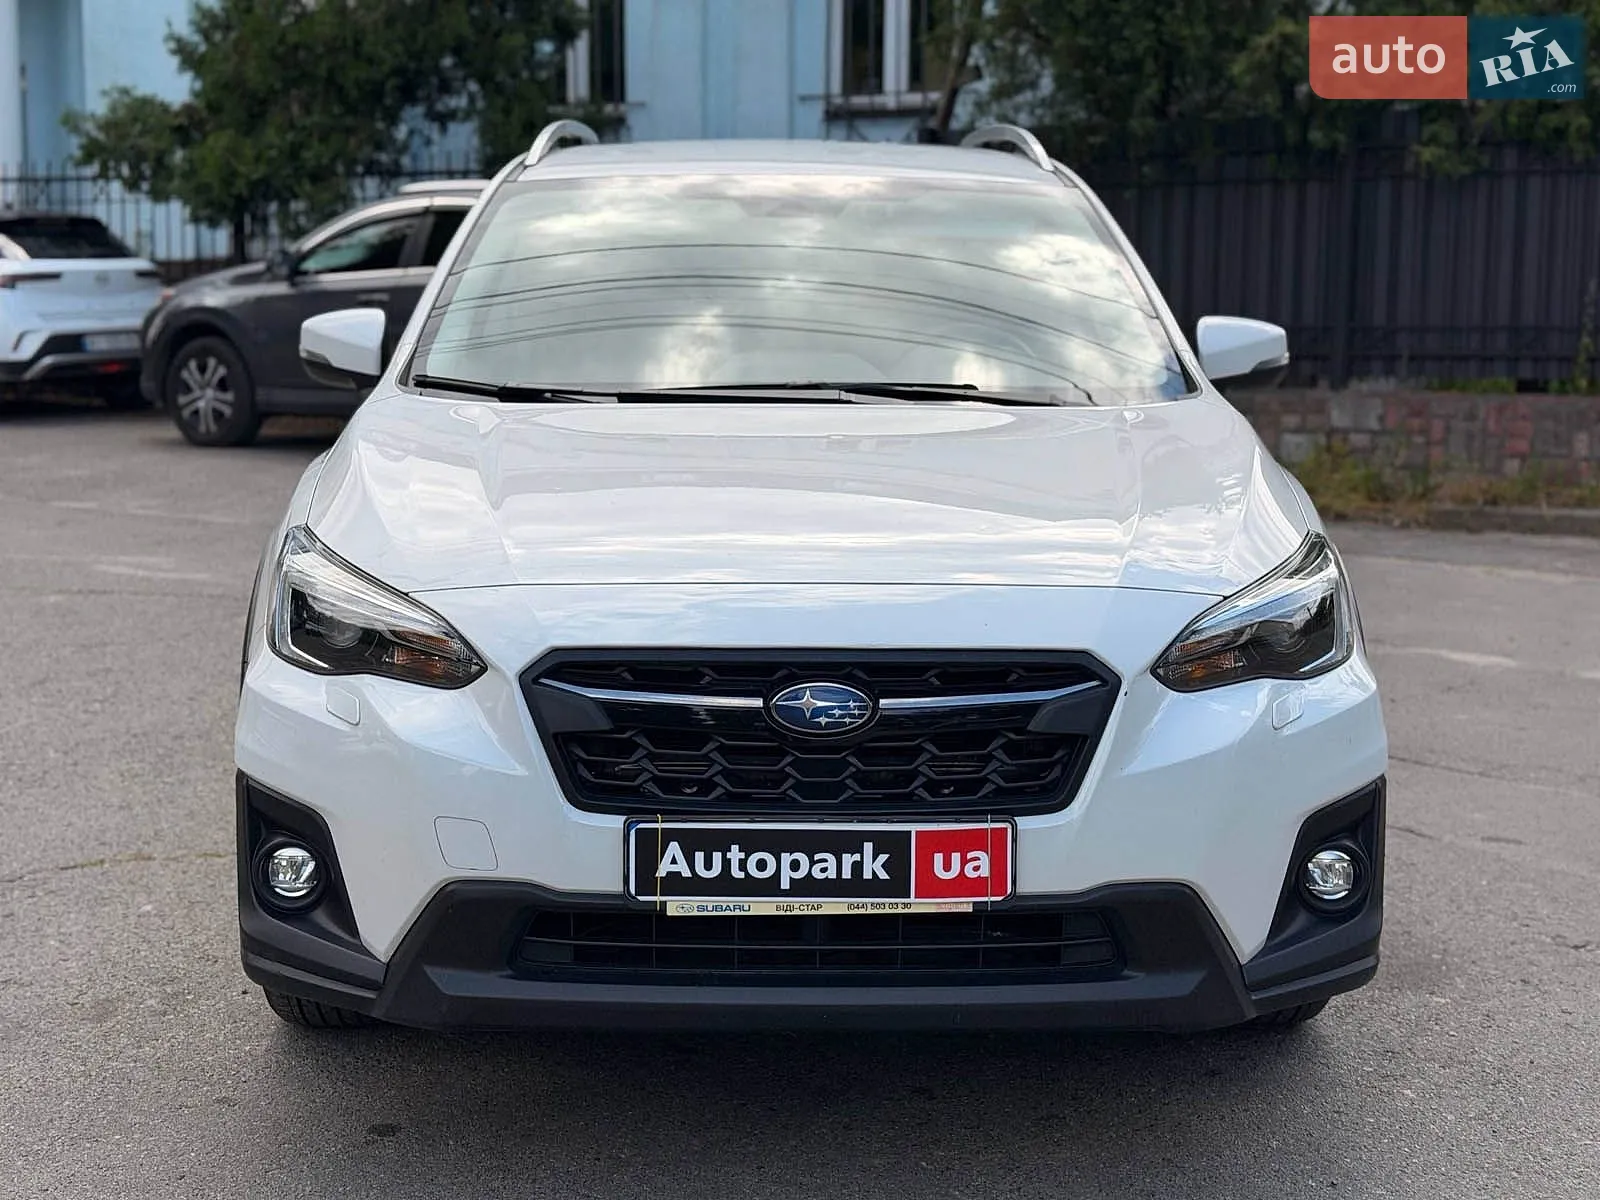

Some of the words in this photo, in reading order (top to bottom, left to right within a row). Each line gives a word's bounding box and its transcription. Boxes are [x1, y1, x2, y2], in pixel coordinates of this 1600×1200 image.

[655, 841, 891, 890] Autopark
[933, 850, 990, 880] ua
[696, 904, 751, 913] SUBARU
[847, 902, 868, 912] (044)
[870, 902, 886, 911] 503
[888, 902, 899, 911] 03
[900, 902, 912, 910] 30
